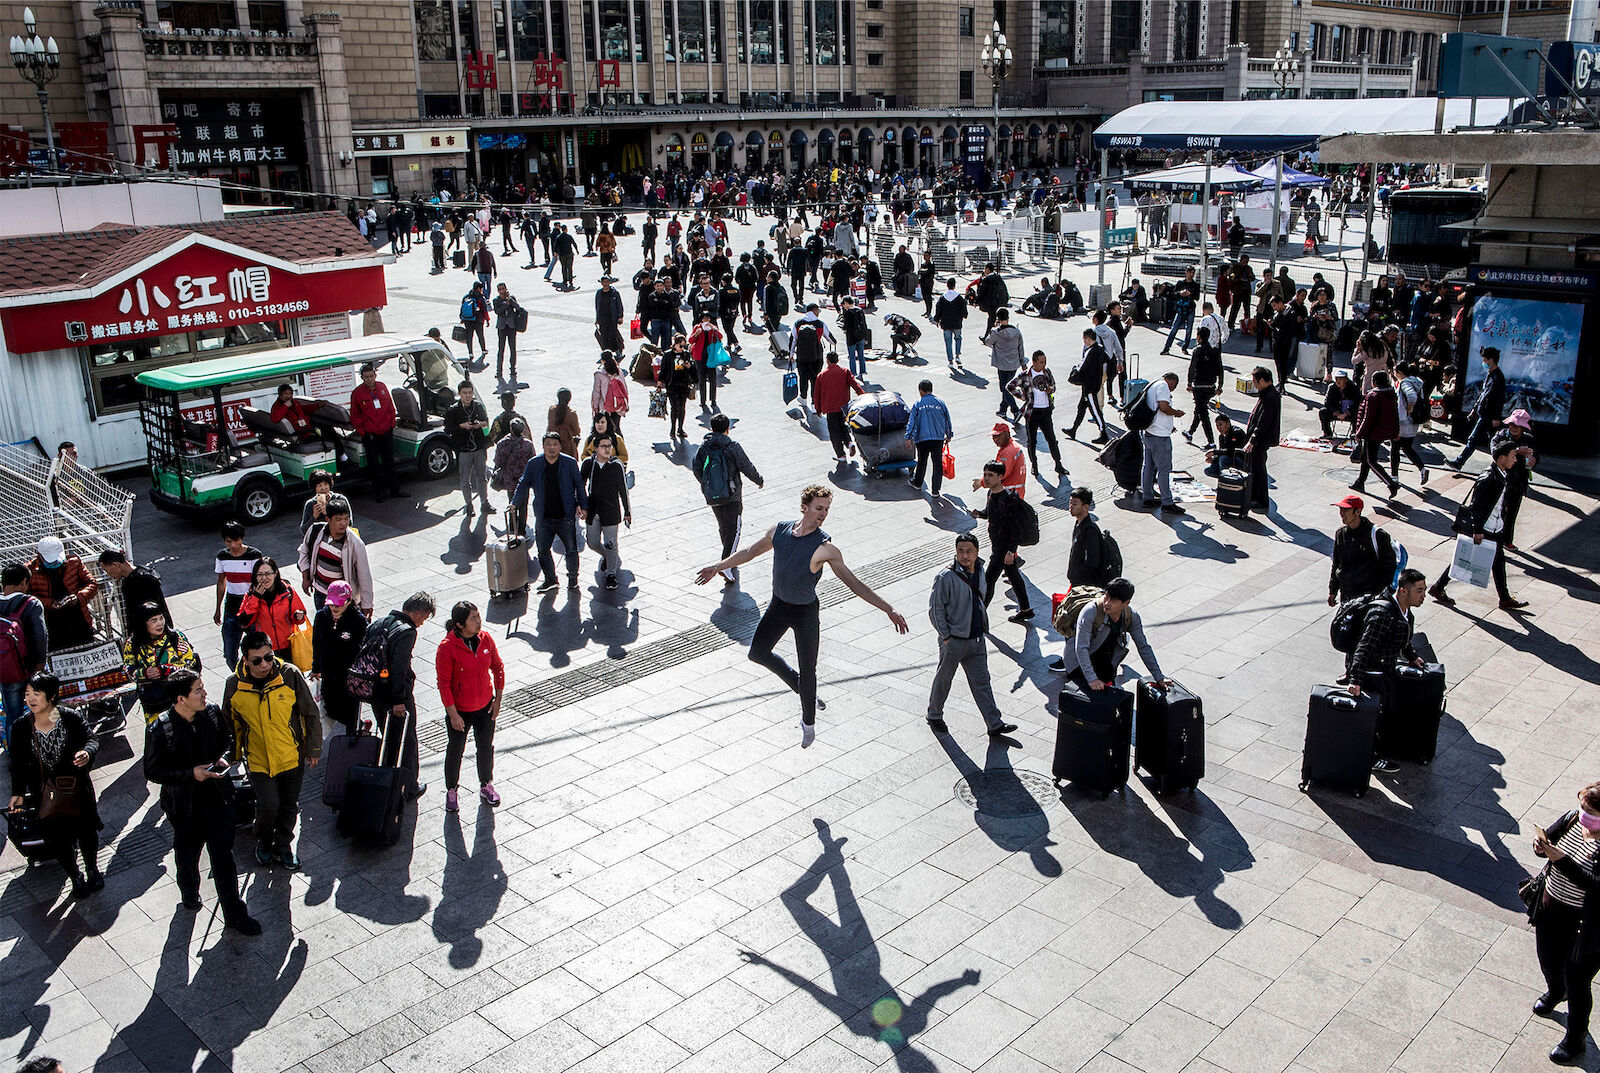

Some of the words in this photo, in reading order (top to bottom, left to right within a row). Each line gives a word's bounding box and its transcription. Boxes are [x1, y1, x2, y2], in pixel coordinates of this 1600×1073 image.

[467, 50, 620, 90] 出站口
[522, 93, 577, 110] EXIT
[163, 103, 199, 118] 网吧
[227, 102, 261, 117] 寄存
[166, 124, 264, 140] 联超市
[355, 137, 398, 148] 空售票
[430, 135, 455, 147] 超市
[118, 266, 271, 316] 小红帽
[91, 318, 159, 339] 搬运服务处
[228, 300, 309, 321] 010-51834569
[181, 408, 217, 422] 共卫生
